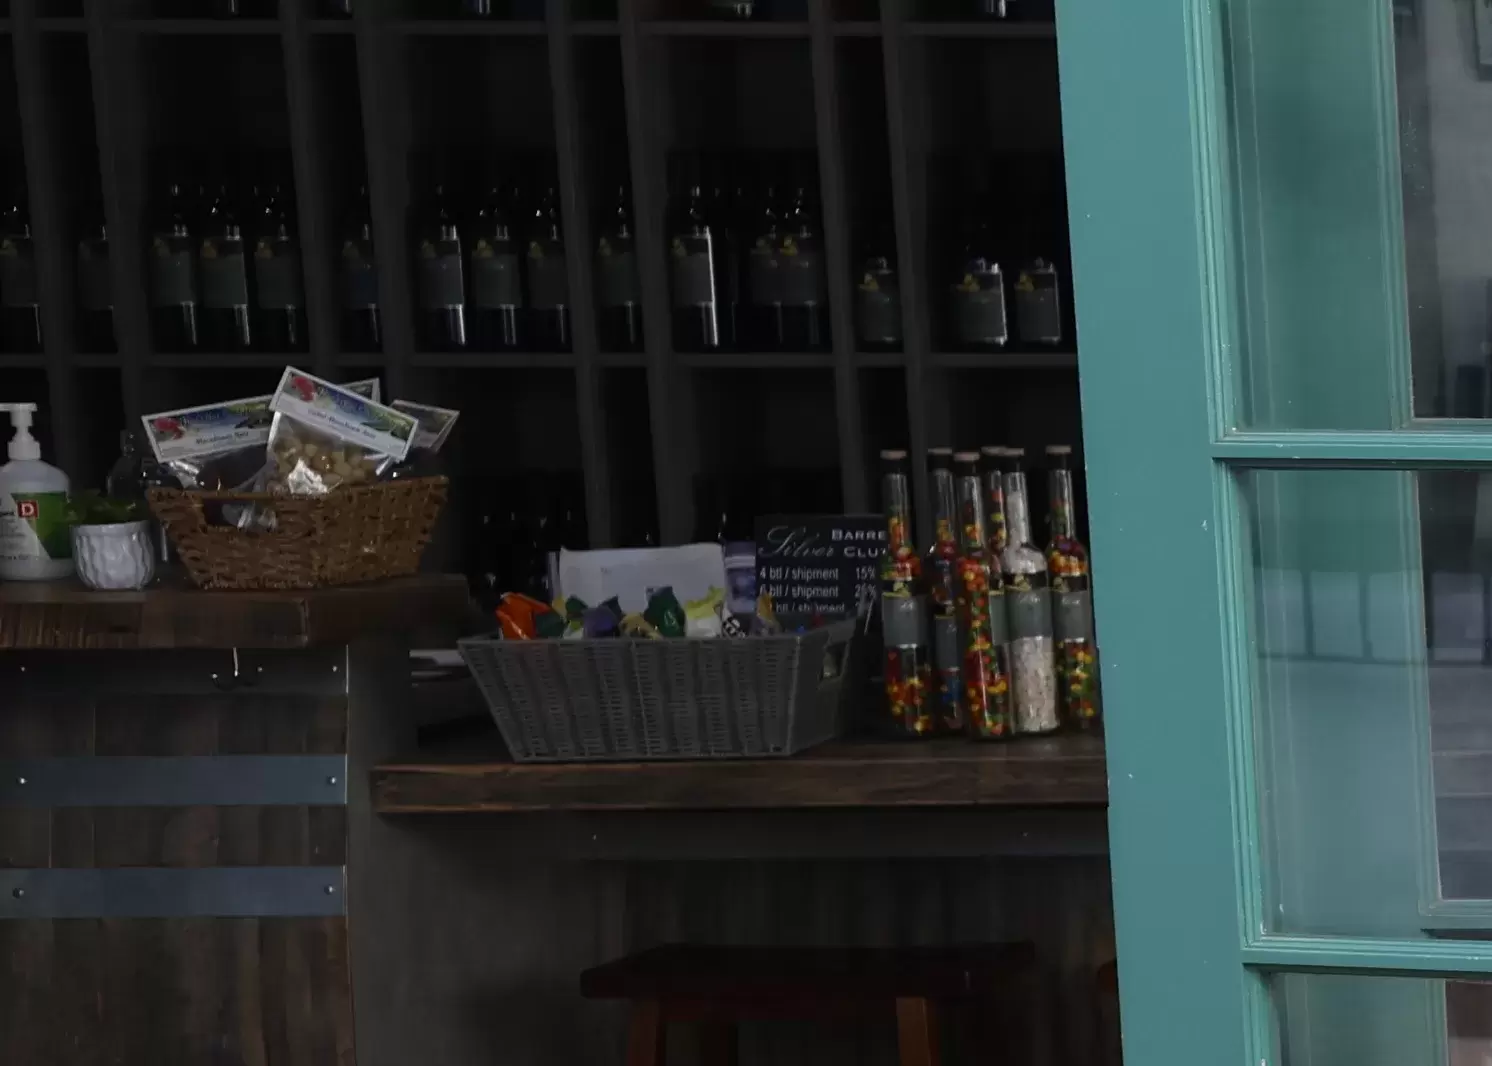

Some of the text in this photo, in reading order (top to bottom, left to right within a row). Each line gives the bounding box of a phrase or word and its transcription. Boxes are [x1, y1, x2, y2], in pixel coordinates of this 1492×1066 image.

[758, 525, 834, 558] Silver
[831, 529, 888, 541] BARRE
[760, 566, 767, 579] 4
[769, 566, 783, 579] btl
[791, 566, 839, 582] shipment
[855, 565, 876, 580] 15%
[791, 585, 839, 599] shipment
